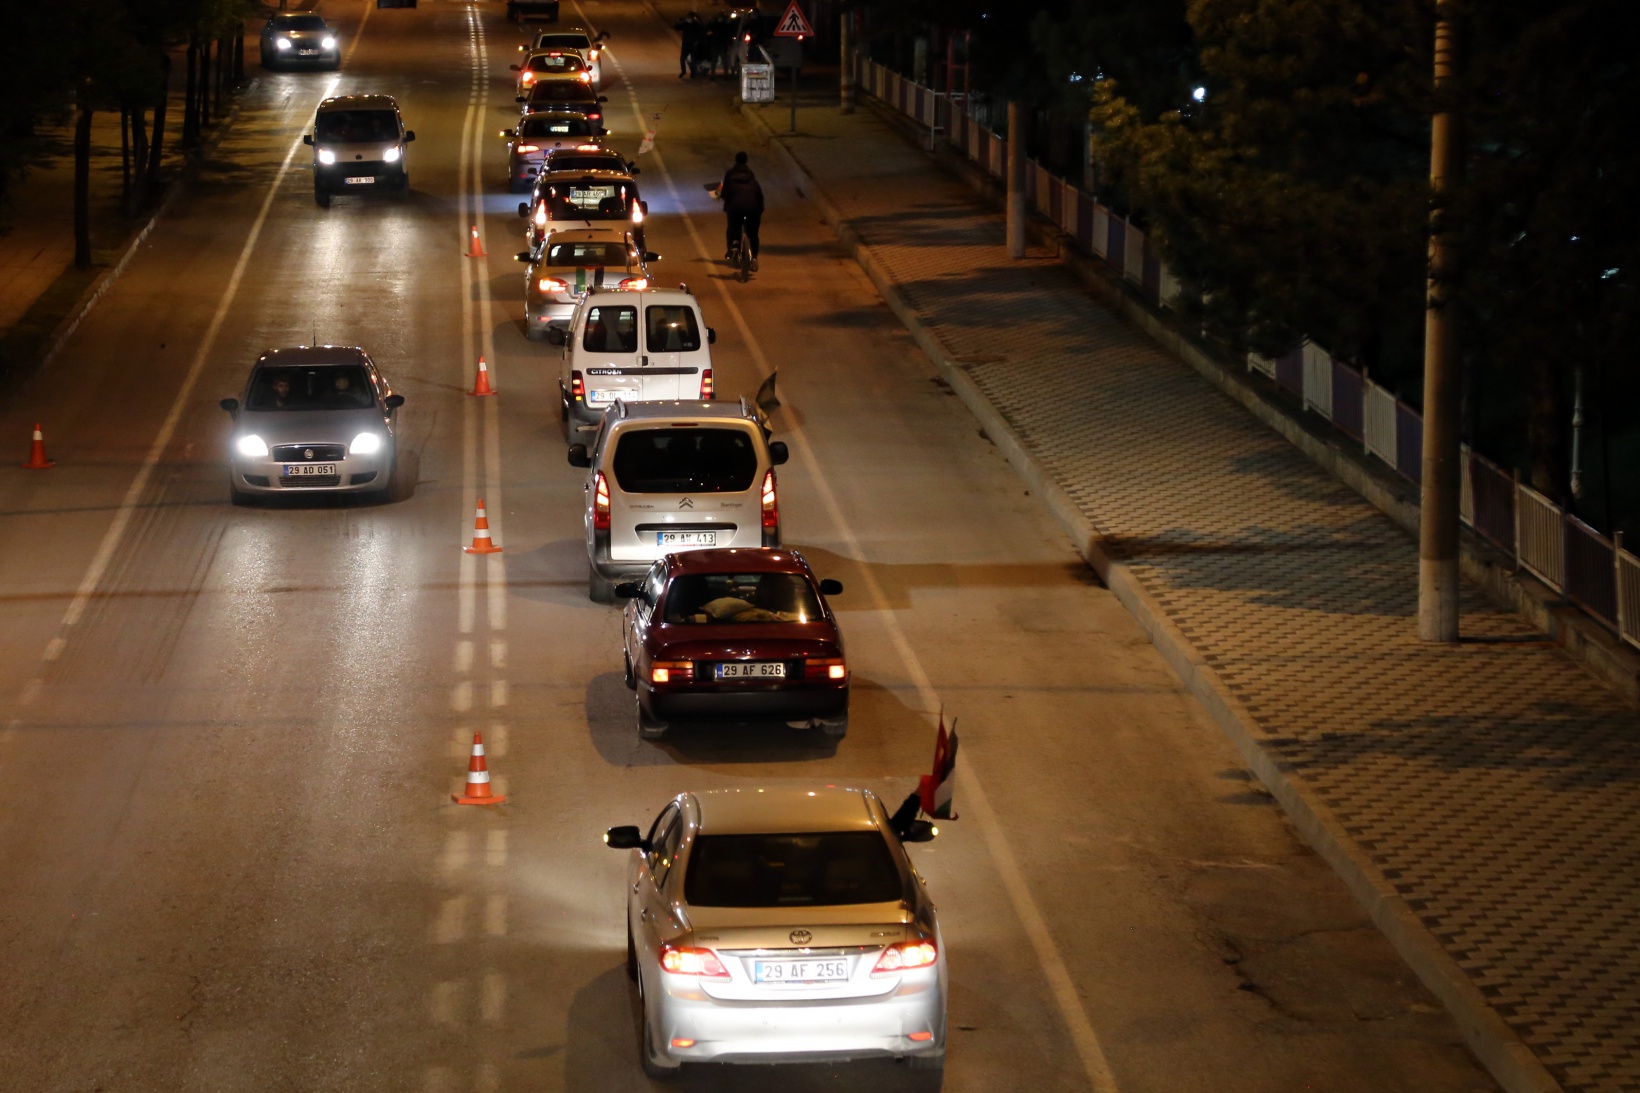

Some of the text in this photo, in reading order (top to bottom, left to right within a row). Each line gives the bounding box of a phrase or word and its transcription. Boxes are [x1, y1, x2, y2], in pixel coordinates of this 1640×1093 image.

[596, 392, 605, 400] 29
[289, 466, 300, 475] 29
[317, 465, 333, 474] 051
[664, 534, 676, 544] 29
[696, 533, 714, 543] 413
[724, 664, 782, 676] 29 AF 626
[764, 962, 844, 979] 29 AF 256
